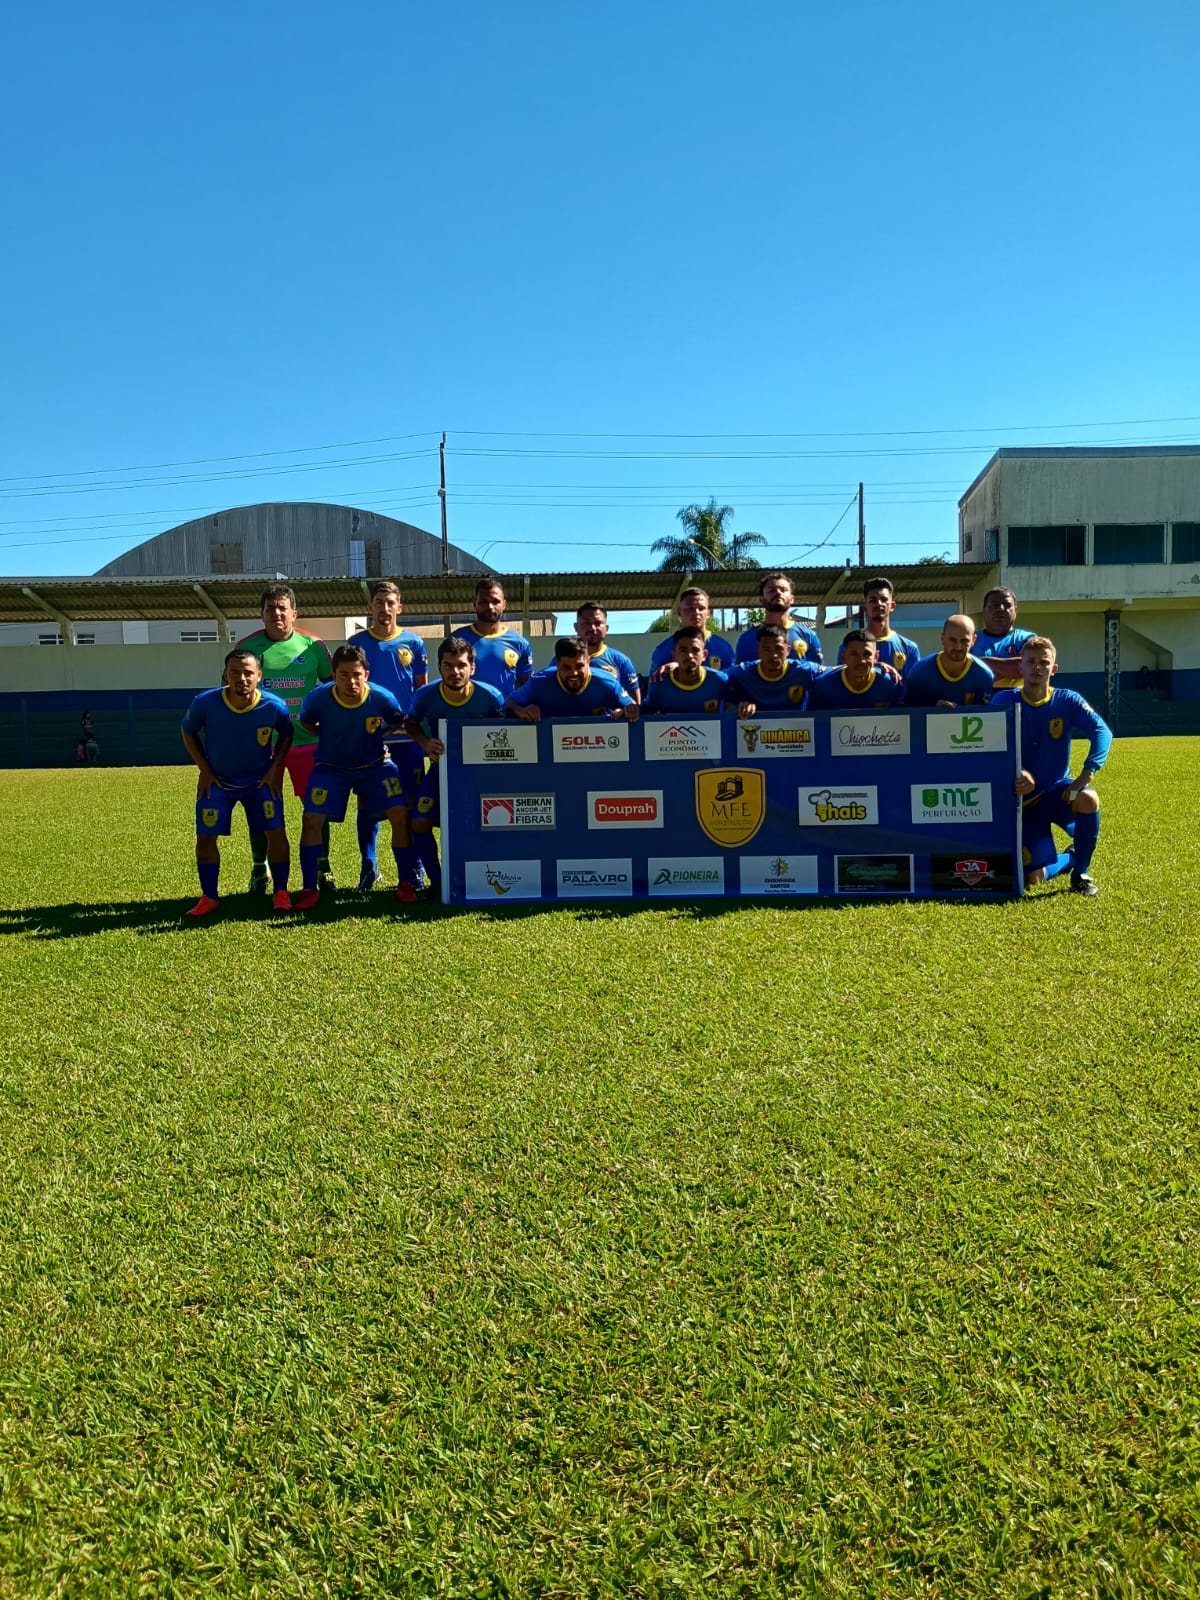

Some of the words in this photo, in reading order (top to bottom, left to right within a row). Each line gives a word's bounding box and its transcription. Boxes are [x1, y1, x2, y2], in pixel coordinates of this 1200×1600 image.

[839, 725, 901, 745] Chiochetta
[950, 716, 983, 744] J2
[562, 736, 606, 746] SOLA
[760, 728, 811, 744] DINÂMICA
[383, 778, 403, 797] 12
[516, 798, 552, 807] SHEIKAN
[598, 803, 654, 816] Douprah
[711, 801, 751, 819] MFE
[922, 809, 981, 817] PERFURAÇÃO
[516, 815, 552, 824] FIBRAS
[962, 863, 980, 871] JA
[562, 875, 627, 883] PALAVRO
[673, 870, 719, 880] PIONEIRA
